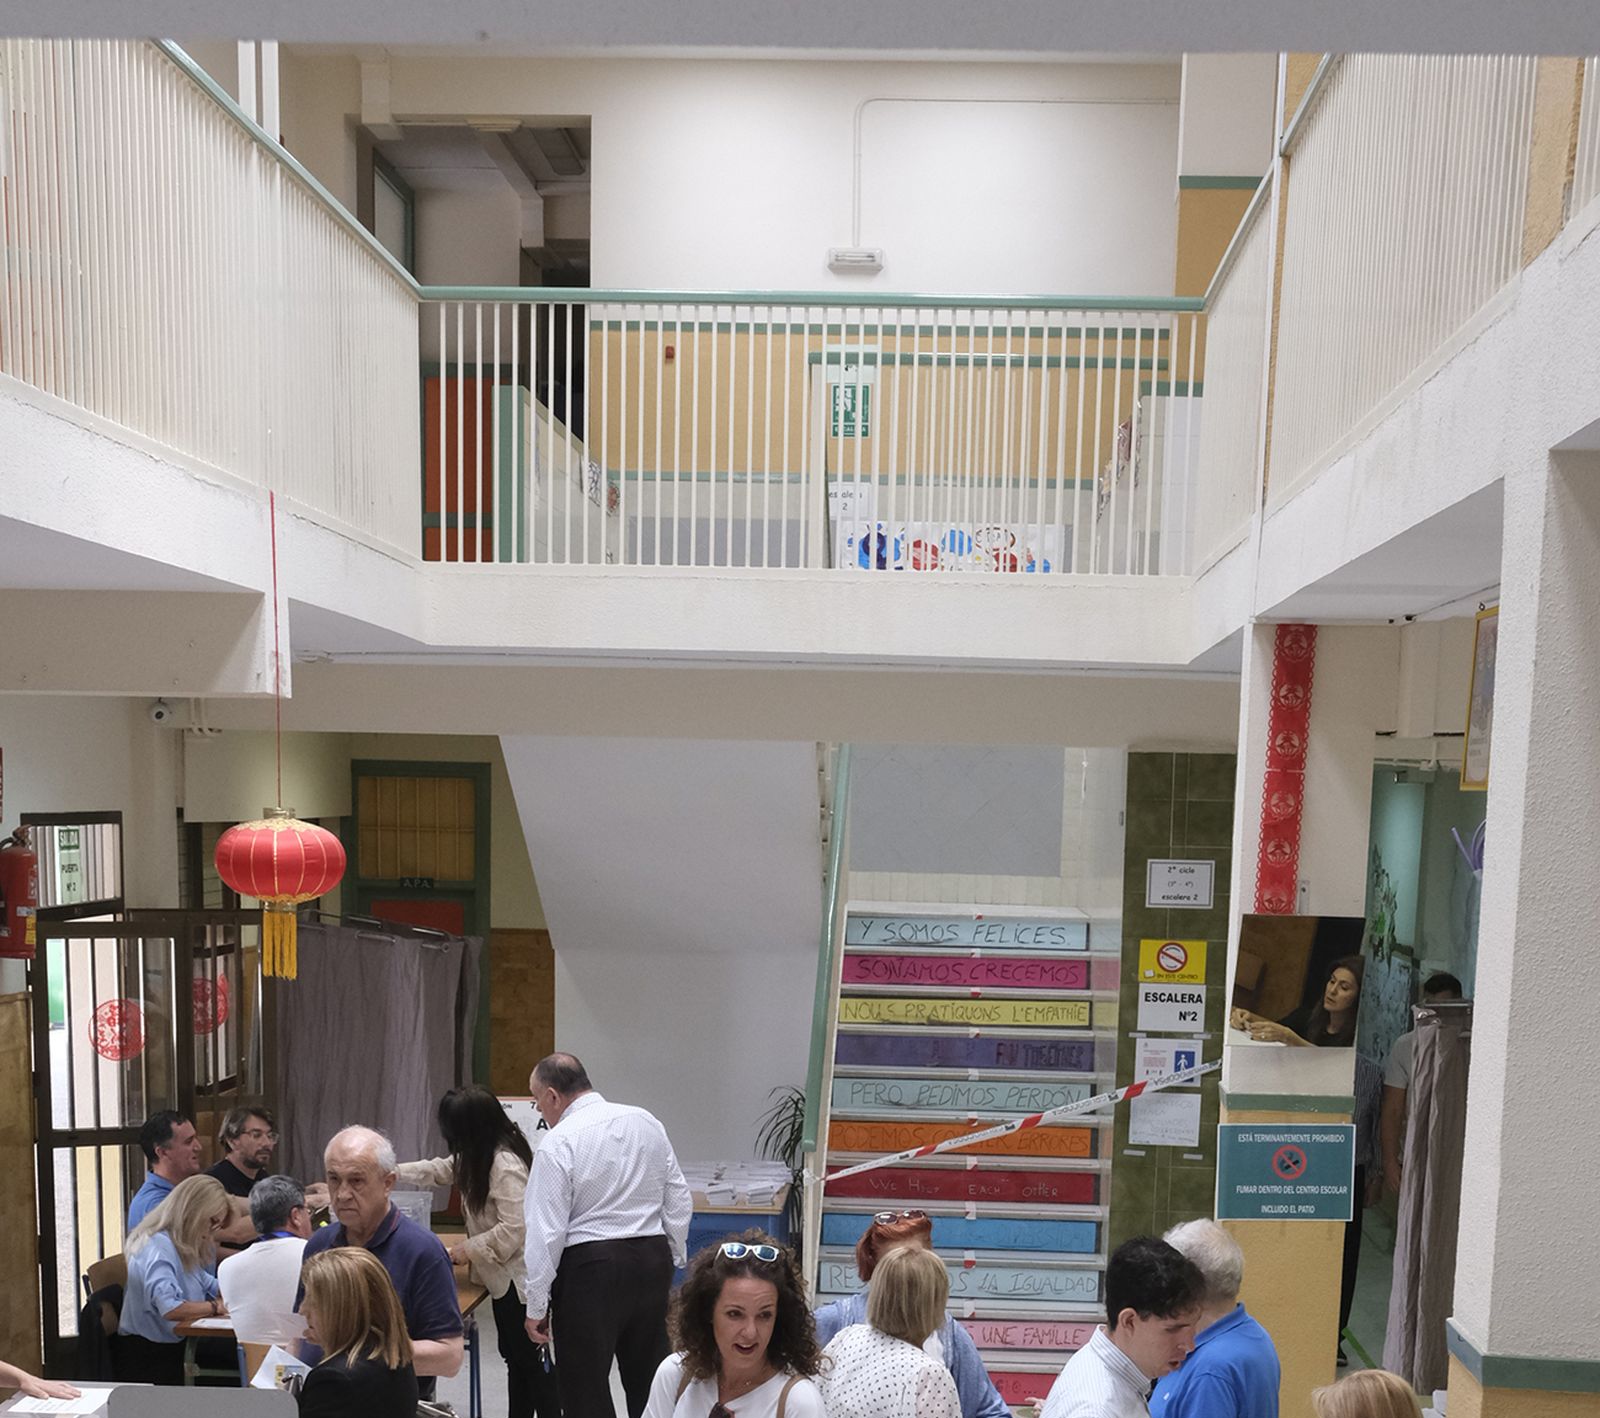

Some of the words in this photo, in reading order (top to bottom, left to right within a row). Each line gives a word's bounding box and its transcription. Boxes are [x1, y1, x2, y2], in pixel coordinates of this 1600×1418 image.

[1161, 893, 1191, 901] escalera
[861, 920, 874, 940] Y
[883, 922, 960, 943] SOMOS
[969, 962, 1080, 984] CRECEMOS
[1144, 992, 1203, 1004] ESCALERA
[850, 1081, 903, 1105] PERO
[829, 1124, 923, 1150] PODEMOS
[1017, 1128, 1090, 1153] ERRORES
[1238, 1132, 1253, 1143] ESTÁ
[1254, 1134, 1311, 1143] TERMINANTEMENTE
[1311, 1134, 1345, 1143] PROHIBIDO
[1236, 1185, 1258, 1194] FUMAR
[1258, 1185, 1282, 1194] DENTRO
[1283, 1185, 1295, 1194] DEL
[1295, 1185, 1320, 1194] CENTRO
[1320, 1185, 1347, 1194] ESCOLAR
[1261, 1205, 1289, 1214] INCLUIDO
[1290, 1205, 1297, 1214] EL
[1297, 1205, 1316, 1214] PATIO
[1008, 1272, 1097, 1297] IGUALDAD
[982, 1328, 1018, 1346] UNE
